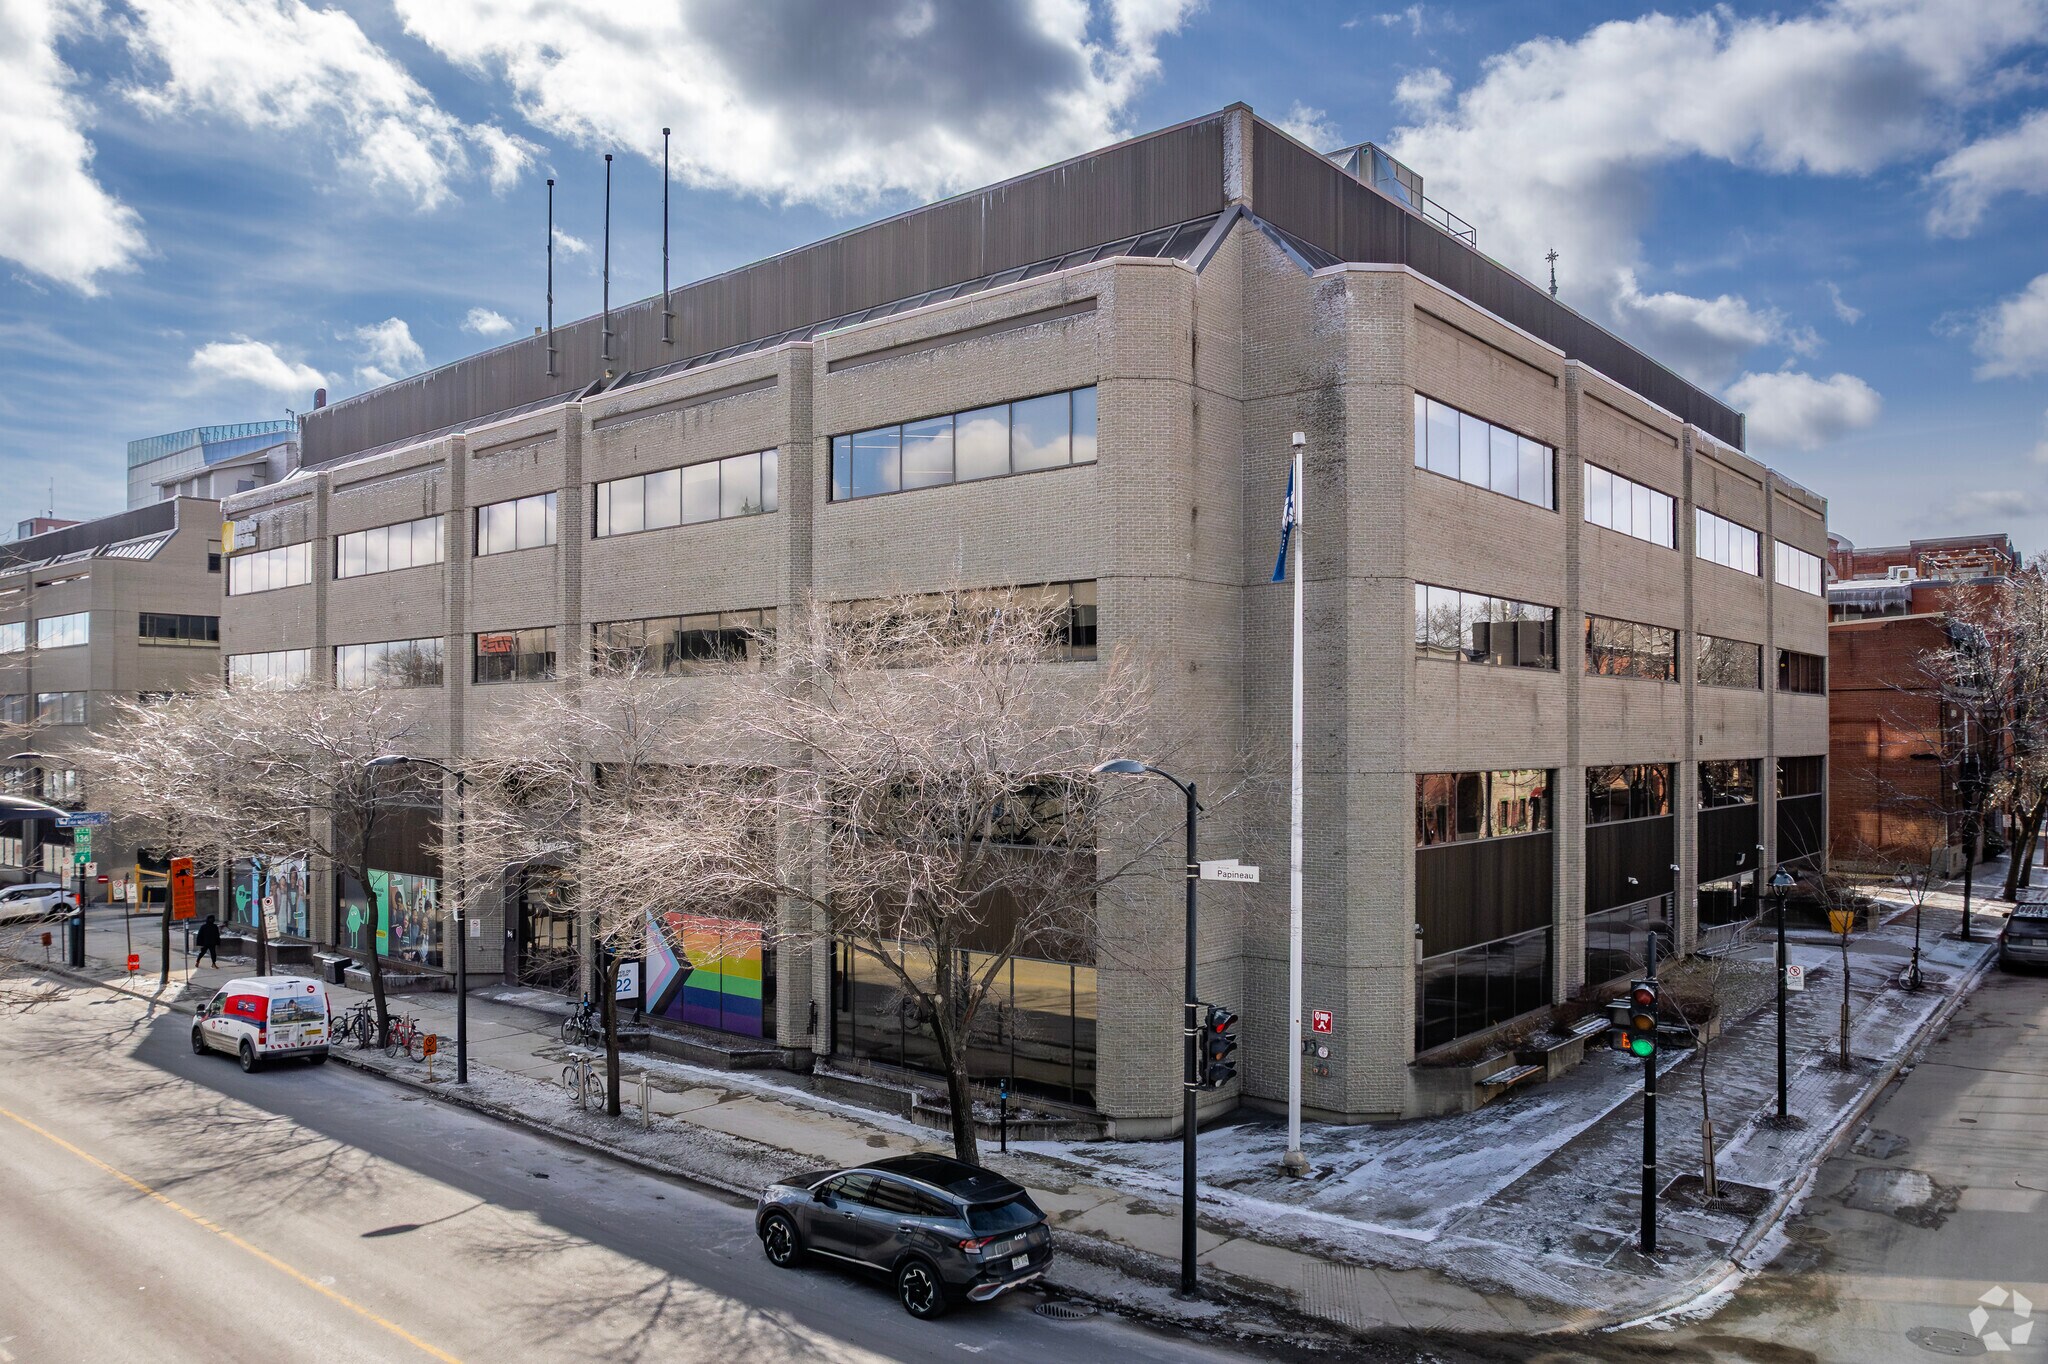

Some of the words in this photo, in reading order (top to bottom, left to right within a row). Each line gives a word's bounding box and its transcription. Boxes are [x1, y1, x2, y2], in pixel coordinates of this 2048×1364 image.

[76, 834, 89, 843] 136
[1217, 869, 1254, 880] Papineau
[616, 978, 632, 993] 22
